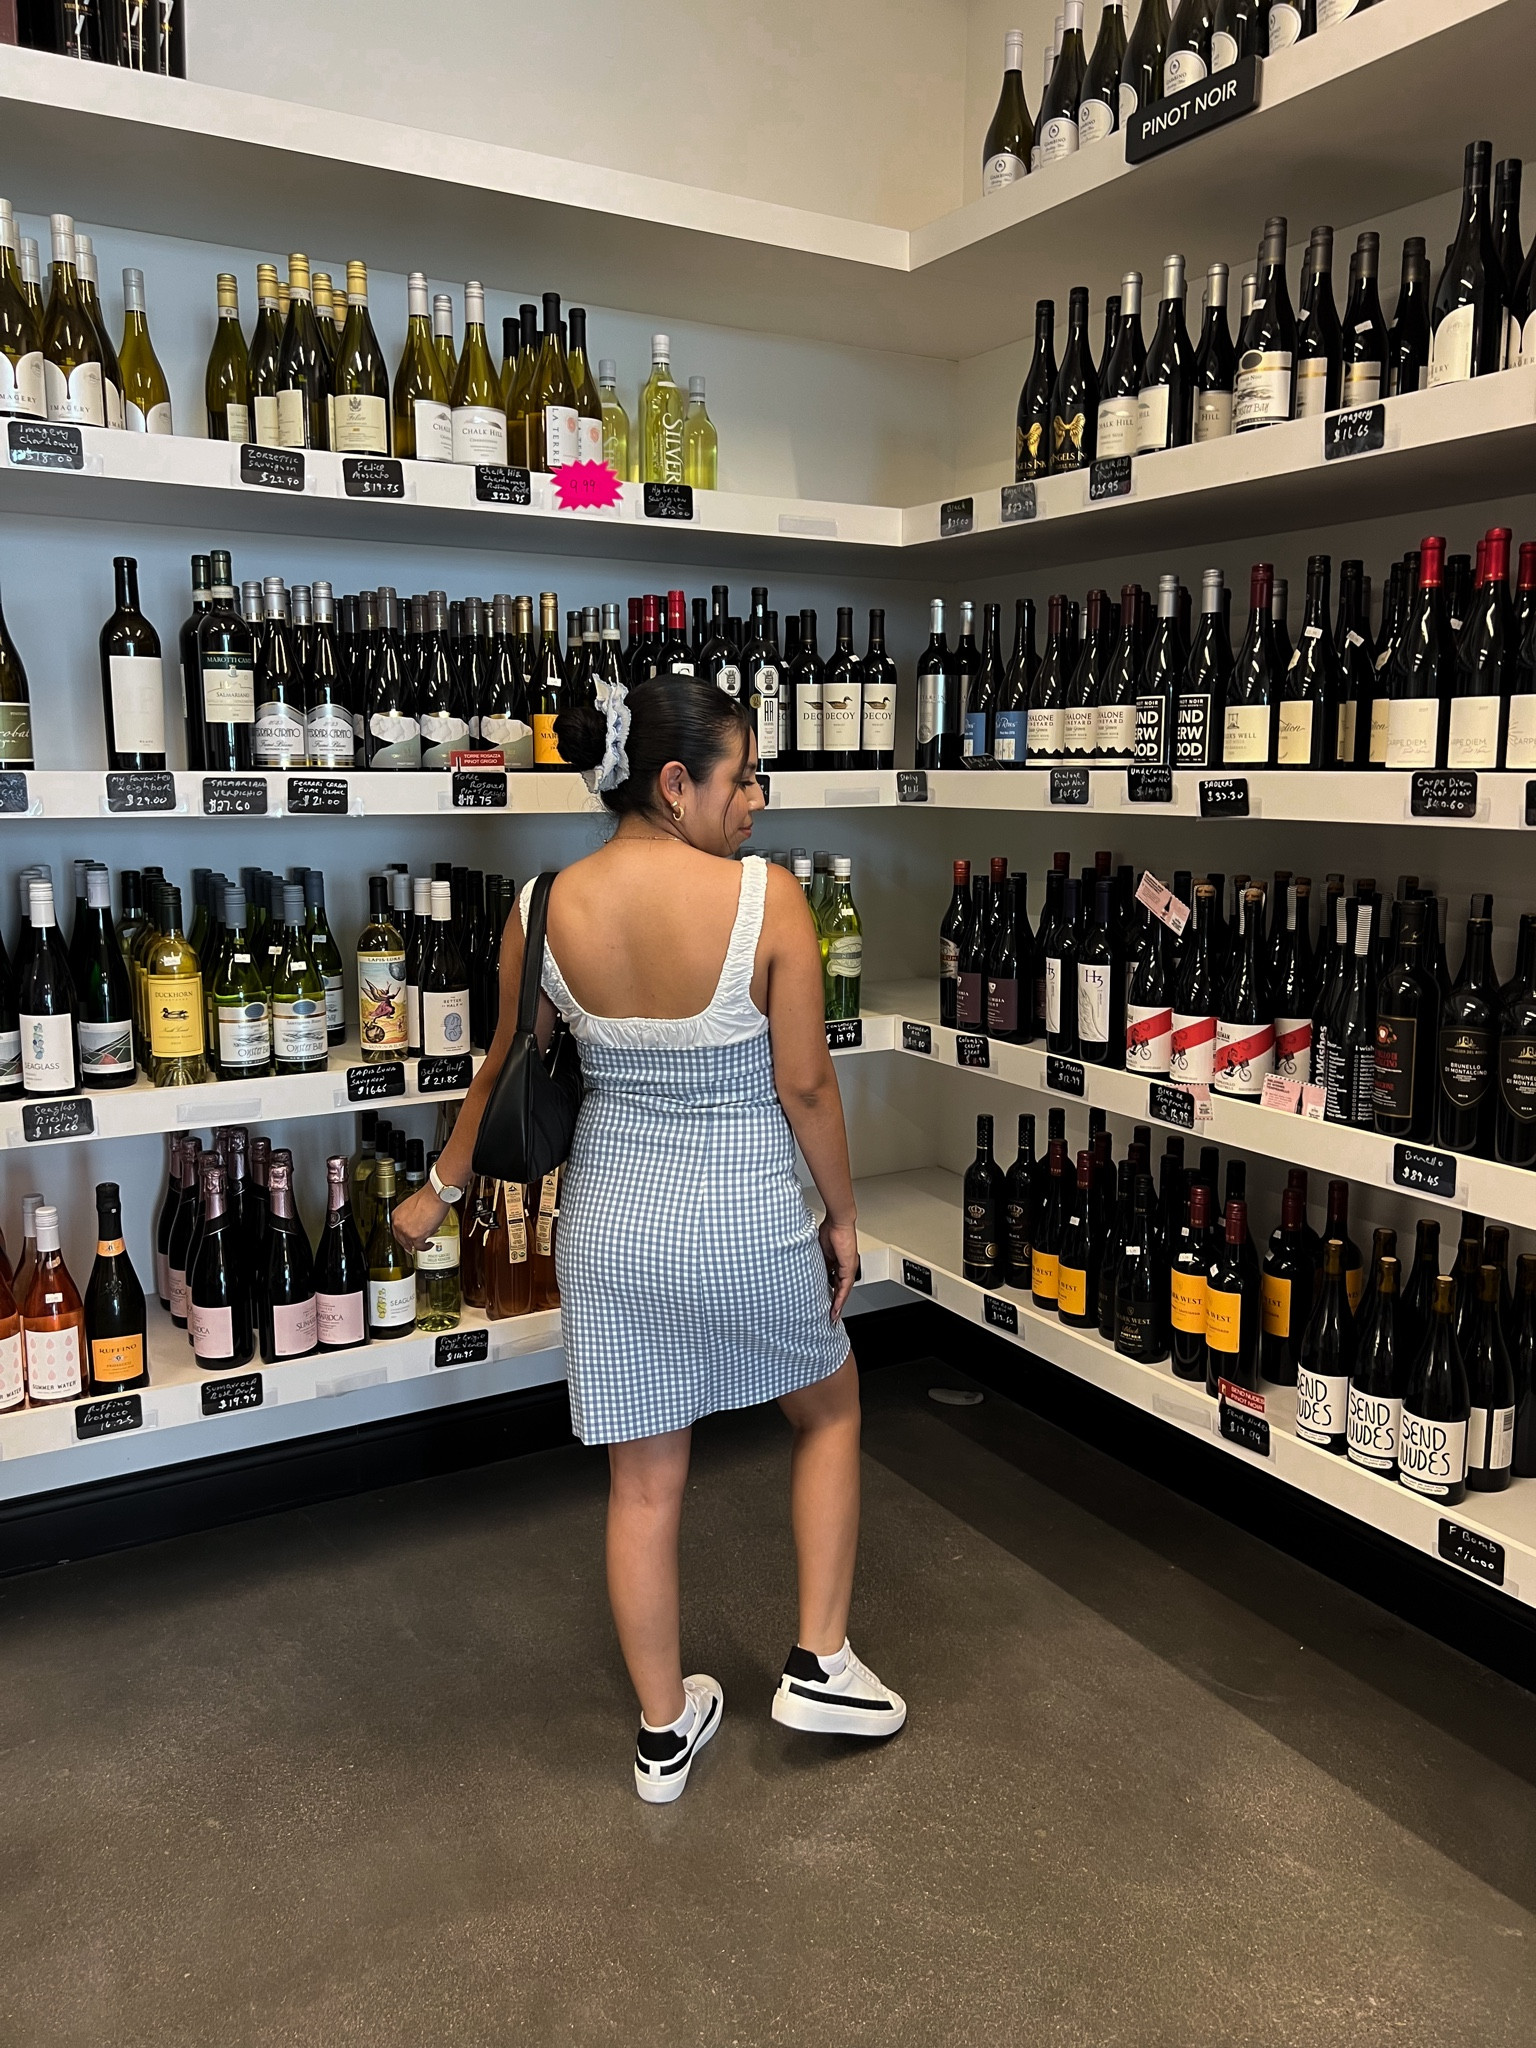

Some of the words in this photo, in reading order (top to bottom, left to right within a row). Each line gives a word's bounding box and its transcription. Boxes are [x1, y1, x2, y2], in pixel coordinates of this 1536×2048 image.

[1142, 101, 1192, 140] PINOT
[1194, 79, 1238, 115] NOIR
[0, 393, 37, 404] MAGERY
[49, 405, 91, 414] IMAGERY
[1116, 418, 1134, 427] HILL
[1338, 409, 1373, 426] Imagery
[20, 424, 69, 441] Imagery
[433, 423, 451, 434] CHAL
[462, 427, 484, 435] CHALK
[488, 428, 504, 438] HILL
[1333, 424, 1369, 443] $16.65
[663, 412, 685, 484] SILVER
[362, 482, 400, 494] $19.75
[206, 655, 237, 664] MAROTTI
[1188, 698, 1204, 706] NOIR
[827, 711, 856, 721] DECOY
[1405, 738, 1427, 747] DIEM
[1465, 737, 1487, 747] DIEM
[1416, 777, 1445, 789] Carpe
[1448, 777, 1473, 787] Diem
[1421, 786, 1448, 797] Pinot
[1449, 788, 1472, 797] Noir
[125, 794, 168, 806] $29.00
[208, 799, 251, 813] $27.60
[154, 990, 194, 999] DUCKHORN
[25, 1062, 60, 1071] SEAGLASS
[1450, 1062, 1481, 1071] BRUNELLO
[1512, 1074, 1536, 1083] BRUNEL
[34, 1101, 77, 1117] Seaglass
[36, 1115, 80, 1130] Riesling
[1401, 1166, 1440, 1187] $89.45
[1036, 1268, 1053, 1277] WEST
[389, 1294, 415, 1307] SEAGLAS
[1180, 1296, 1203, 1305] WEST
[1132, 1318, 1152, 1327] WEST
[1210, 1311, 1232, 1323] WEST
[99, 1343, 138, 1355] RUFFINO
[32, 1383, 56, 1392] SUMMER
[57, 1380, 77, 1390] WATER
[1230, 1386, 1246, 1398] SEND
[5, 1387, 23, 1398] WATER
[1230, 1393, 1248, 1406] PINOT
[1247, 1399, 1264, 1412] NOIR
[1226, 1408, 1245, 1422] Send
[1349, 1391, 1390, 1427] SEND
[1348, 1417, 1395, 1453] NUDES
[1402, 1414, 1447, 1452] SEND
[1400, 1441, 1451, 1477] NUDES
[1461, 1530, 1497, 1553] Bomb
